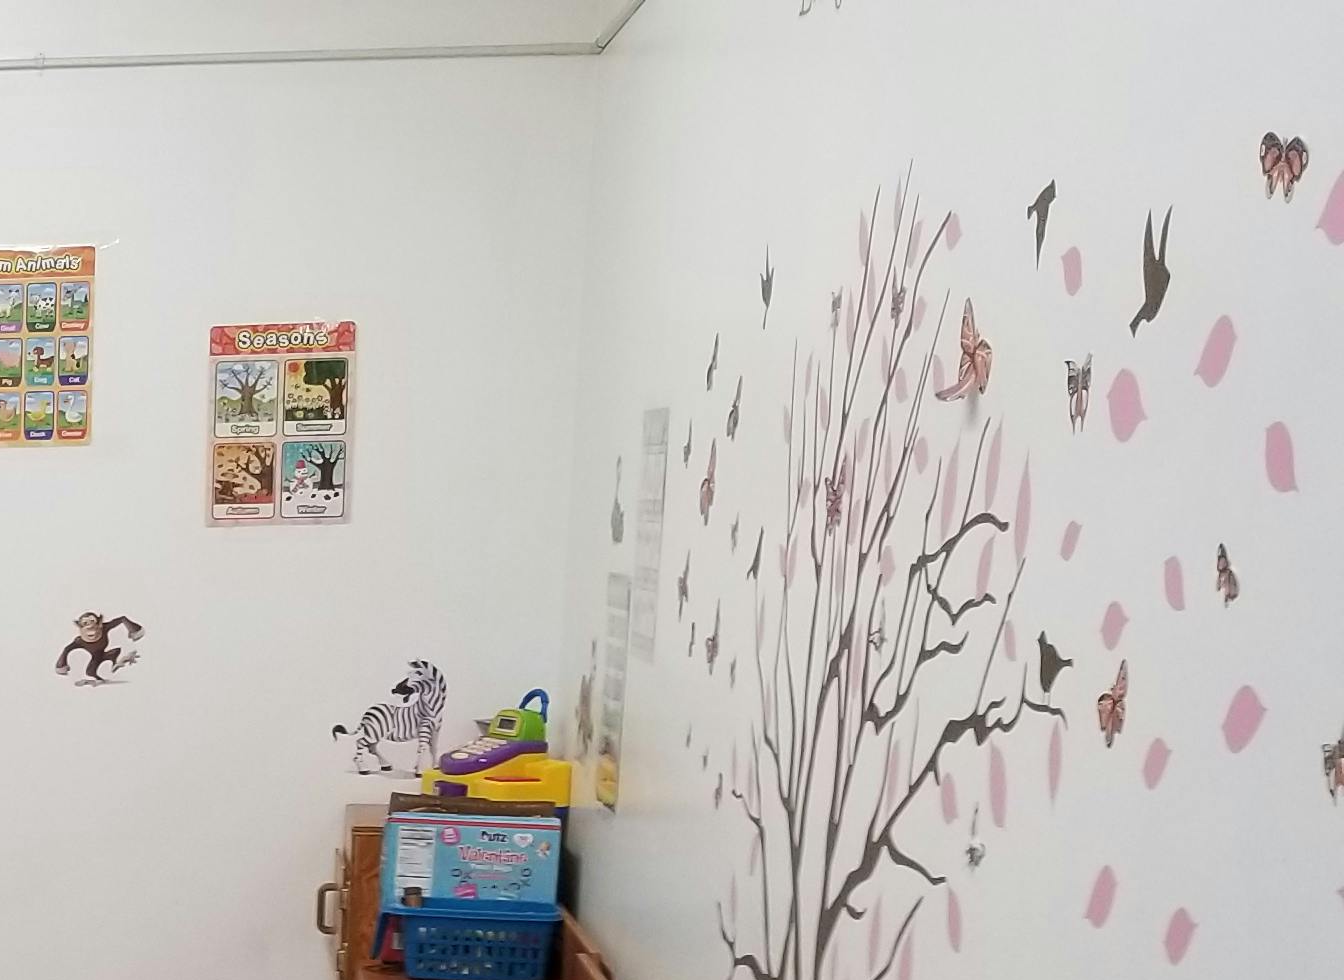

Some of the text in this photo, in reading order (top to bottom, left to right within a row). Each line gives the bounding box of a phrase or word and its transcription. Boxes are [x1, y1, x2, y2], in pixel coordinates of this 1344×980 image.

[15, 254, 81, 272] Animals
[238, 330, 329, 350] Seasons
[231, 424, 260, 435] Spring
